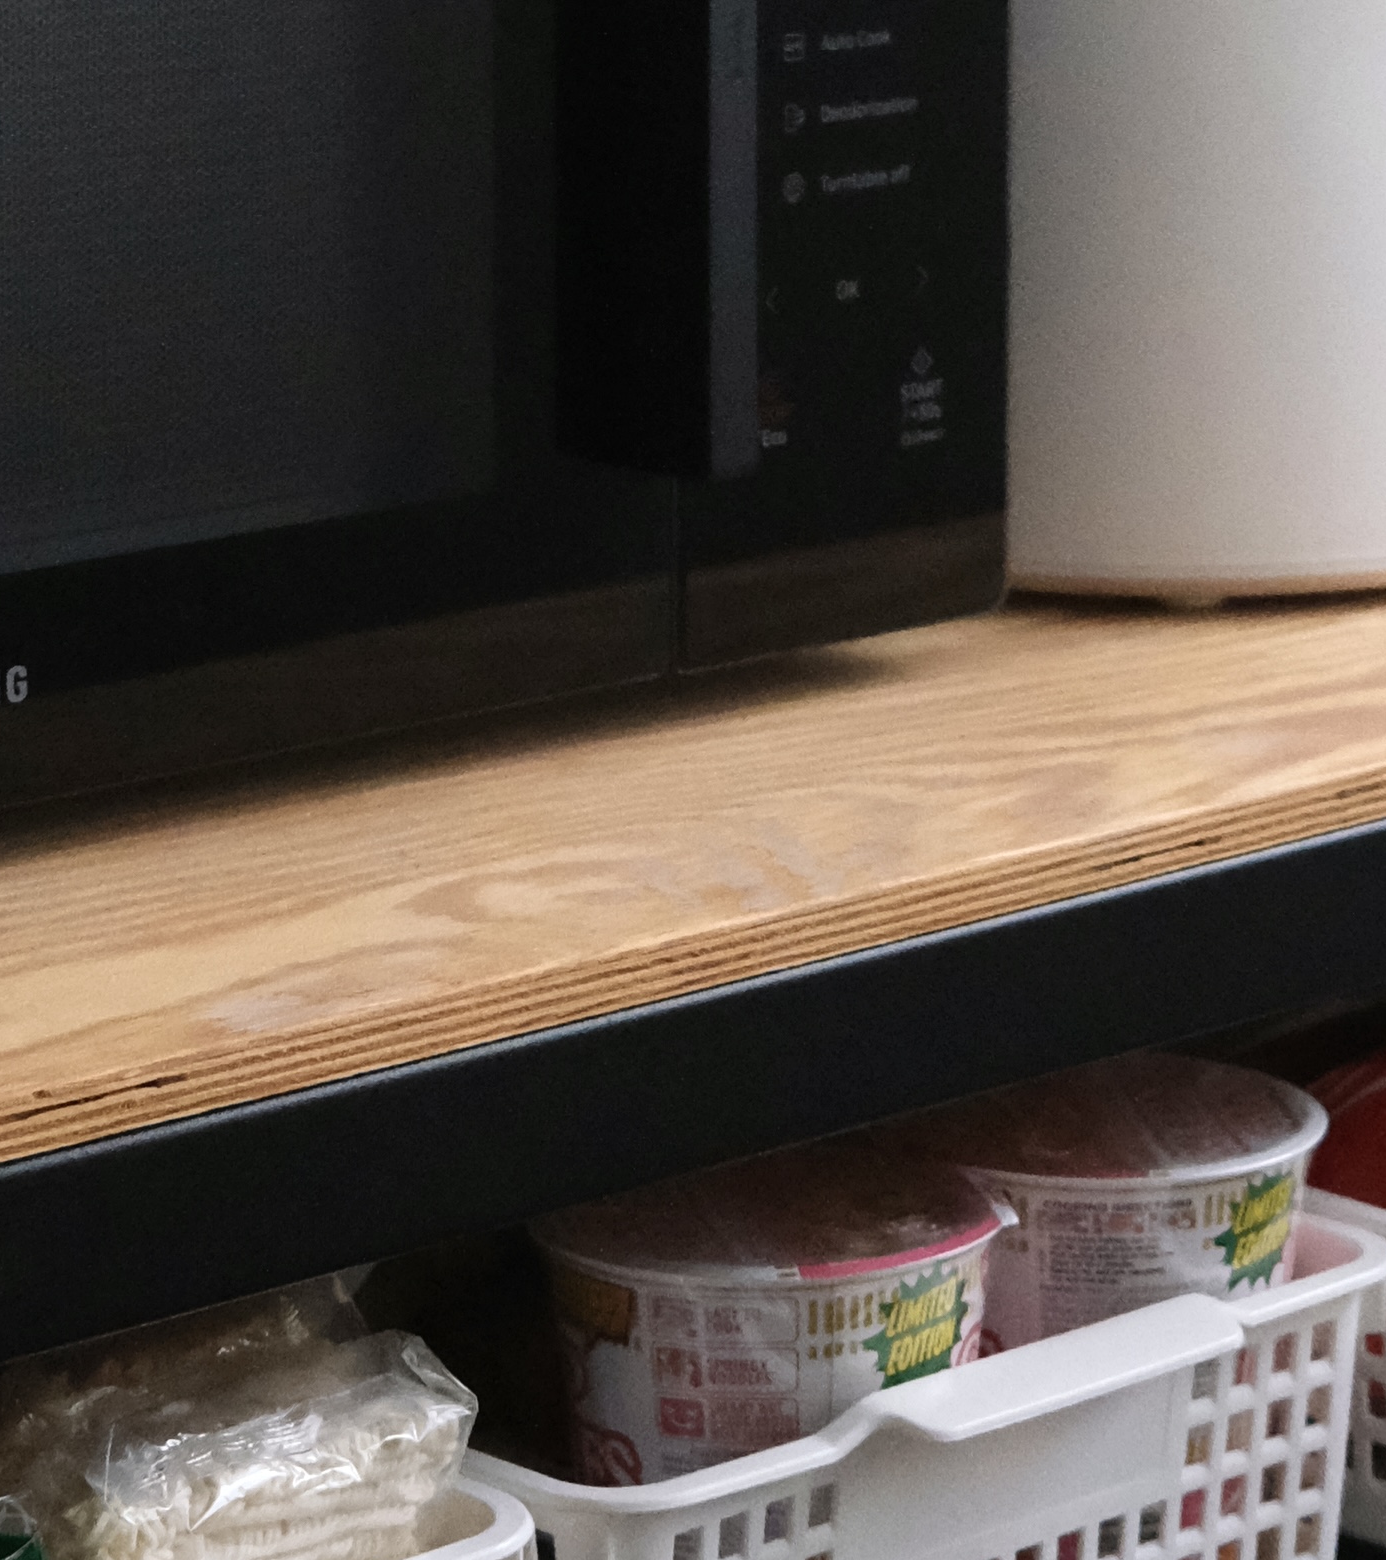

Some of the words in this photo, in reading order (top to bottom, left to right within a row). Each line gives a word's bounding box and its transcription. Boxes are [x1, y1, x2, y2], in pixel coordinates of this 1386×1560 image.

[820, 33, 855, 52] Auto
[835, 279, 861, 302] OK
[885, 1278, 959, 1341] LIMITED
[883, 1316, 957, 1378] EDITION
